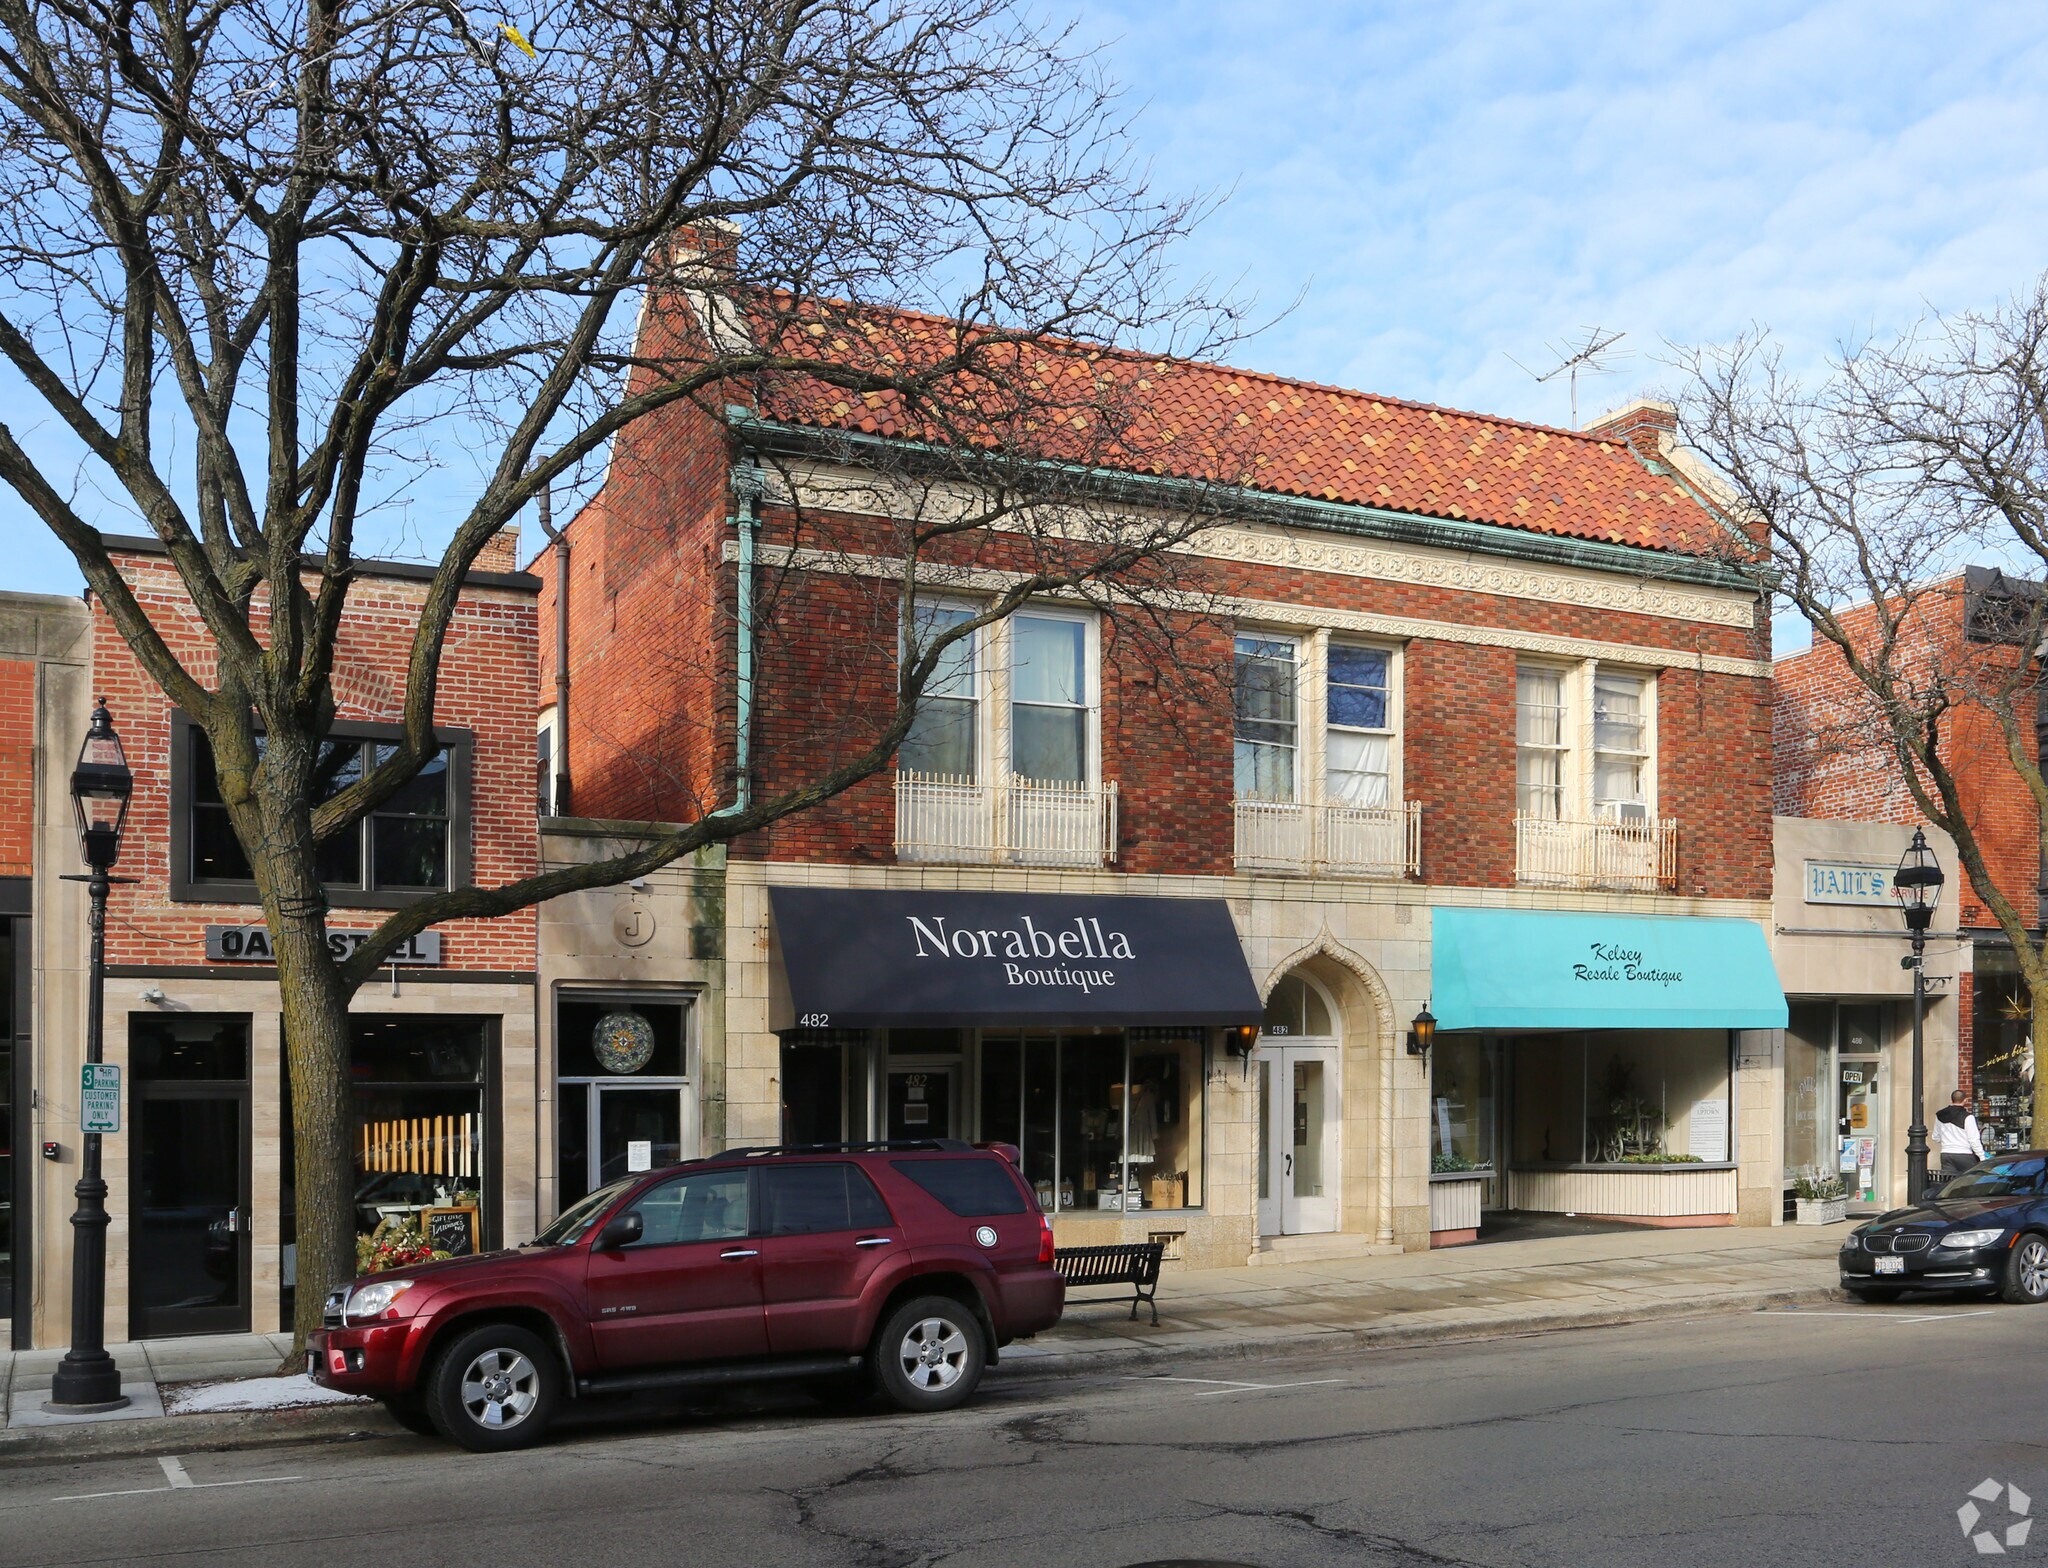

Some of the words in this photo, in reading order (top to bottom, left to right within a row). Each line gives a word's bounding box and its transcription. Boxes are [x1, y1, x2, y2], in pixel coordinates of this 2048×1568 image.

[1813, 868, 1885, 896] PAUL'S
[1890, 888, 1929, 899] SERVCE
[625, 912, 642, 936] J
[906, 915, 1136, 959] Norabella
[221, 930, 275, 956] OA
[328, 933, 426, 959] STEL
[1591, 943, 1643, 966] Kelsey
[1003, 961, 1116, 993] Boutique
[1573, 964, 1620, 981] Resale
[1624, 964, 1683, 987] Boutique
[800, 1013, 829, 1027] 482
[1273, 1026, 1288, 1034] 482
[83, 1069, 93, 1086] 3
[102, 1069, 113, 1077] HR
[1845, 1072, 1861, 1081] OPEN
[94, 1079, 118, 1088] PARKING
[905, 1074, 928, 1087] 482
[85, 1091, 117, 1100] CUSTOMER
[87, 1101, 114, 1110] PARKING
[92, 1111, 109, 1120] ONLY
